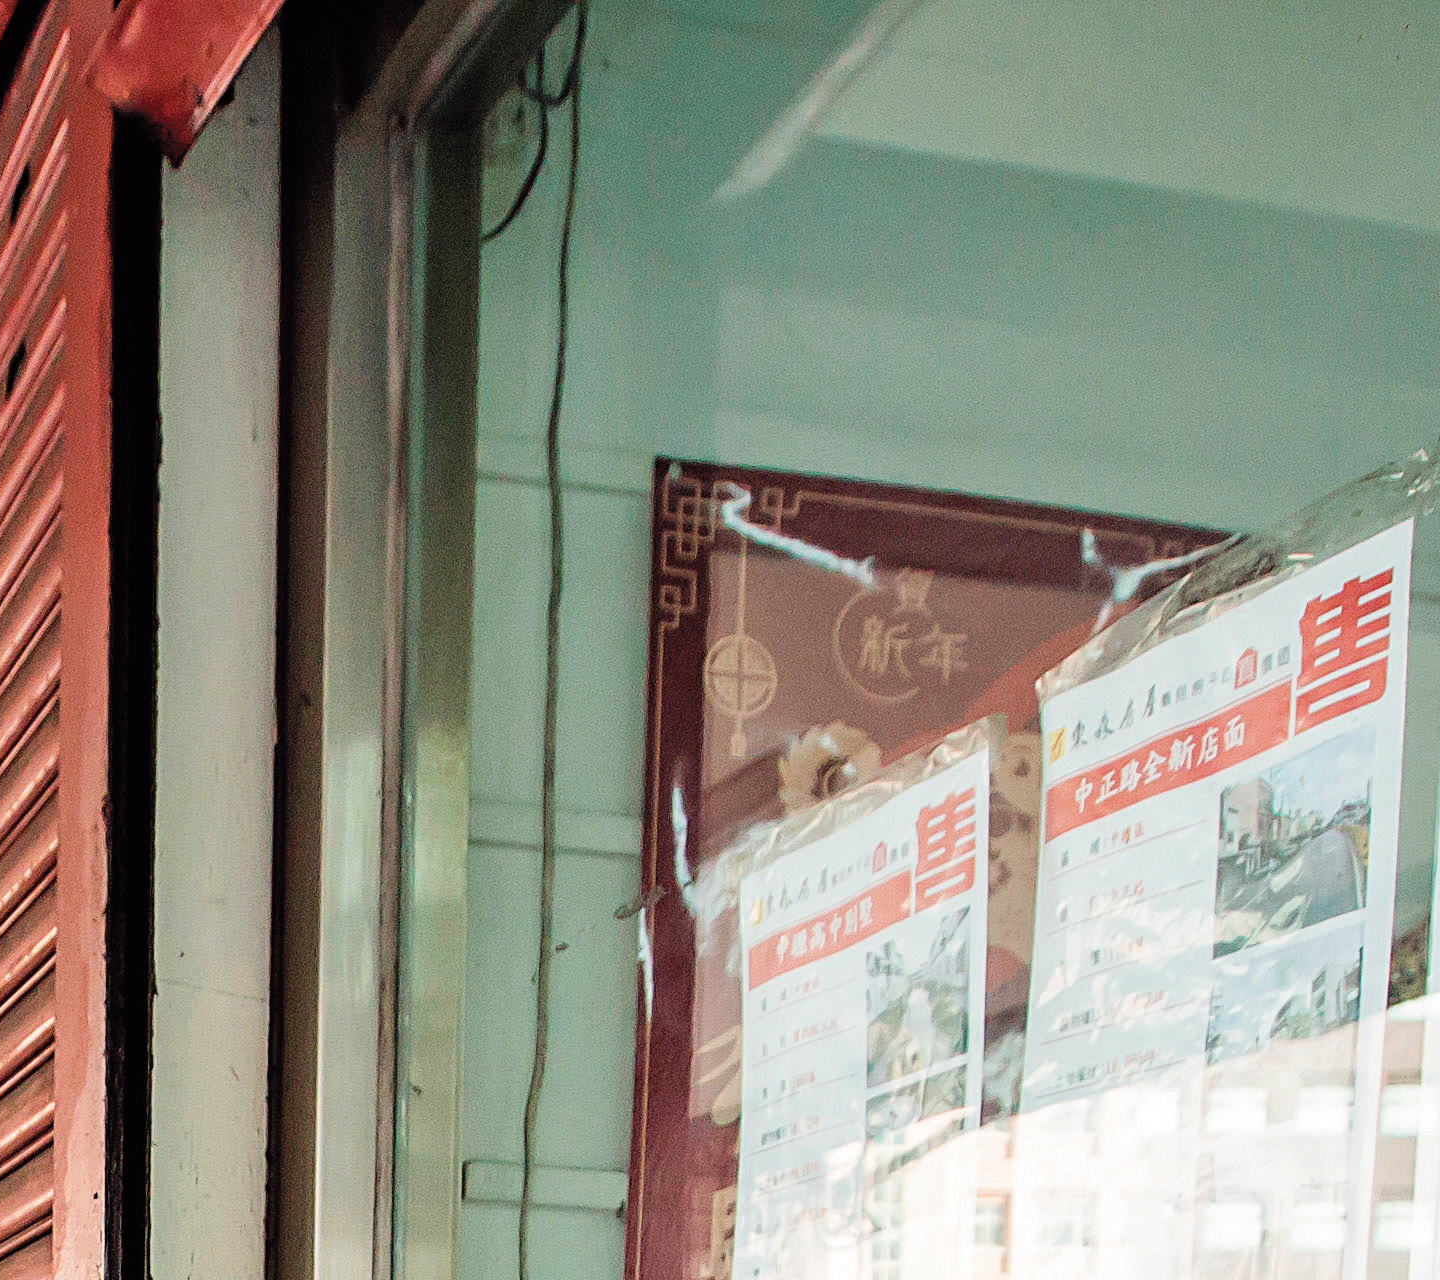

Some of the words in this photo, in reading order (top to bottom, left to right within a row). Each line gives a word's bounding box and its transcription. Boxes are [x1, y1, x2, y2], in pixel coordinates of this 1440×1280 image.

[1294, 566, 1396, 734] 售
[1074, 716, 1245, 813] 中正路全新店面
[915, 787, 976, 914] 售
